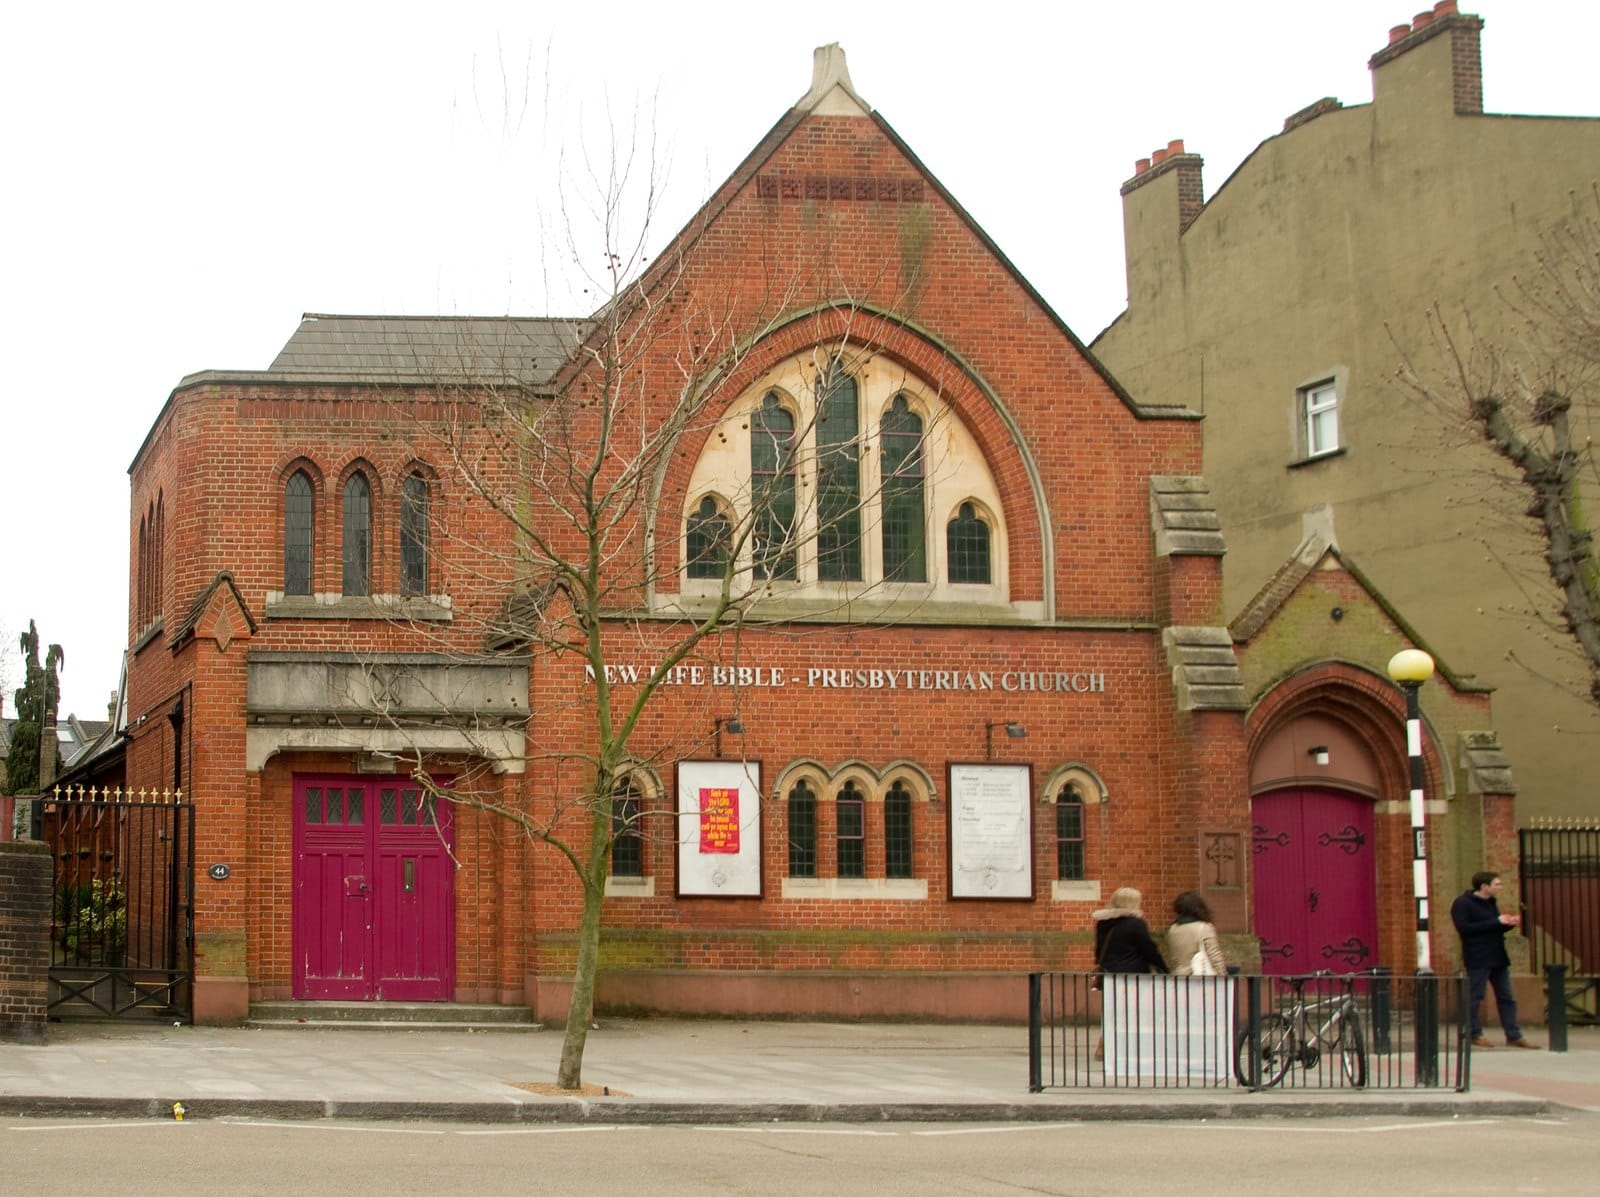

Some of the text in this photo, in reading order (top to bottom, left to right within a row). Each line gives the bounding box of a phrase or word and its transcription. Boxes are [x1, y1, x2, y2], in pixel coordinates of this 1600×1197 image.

[583, 664, 642, 684] NEW
[712, 666, 785, 687] BIBLE
[807, 668, 994, 691] PRESBYTERIAN
[1001, 671, 1105, 693] CHURCH
[215, 867, 225, 875] 44
